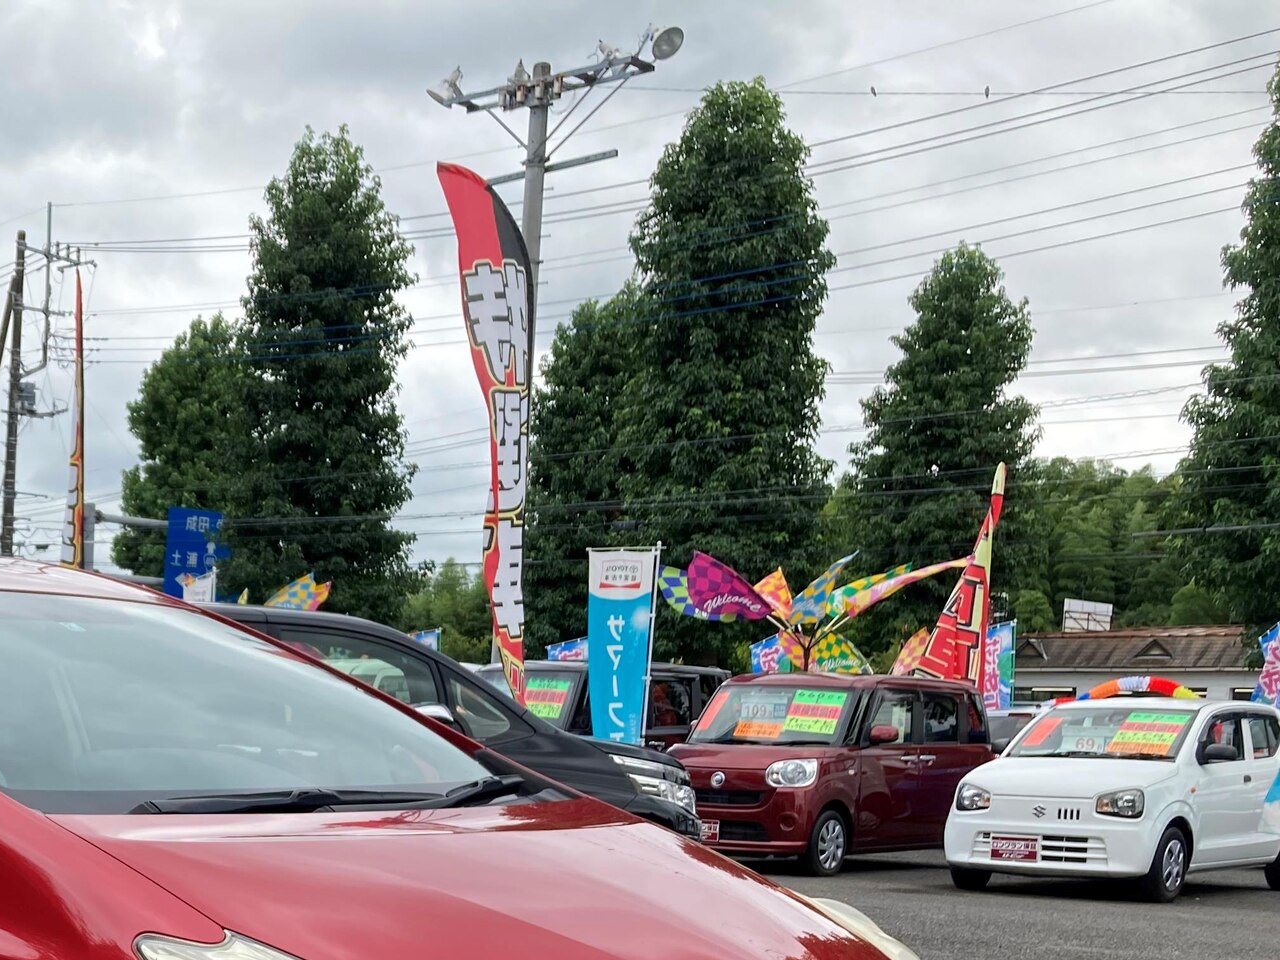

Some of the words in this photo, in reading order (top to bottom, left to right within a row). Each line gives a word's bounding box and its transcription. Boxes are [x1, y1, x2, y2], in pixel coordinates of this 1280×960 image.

[170, 549, 198, 568] 土浦
[703, 592, 762, 613] Welcome
[1075, 737, 1095, 750] 69
